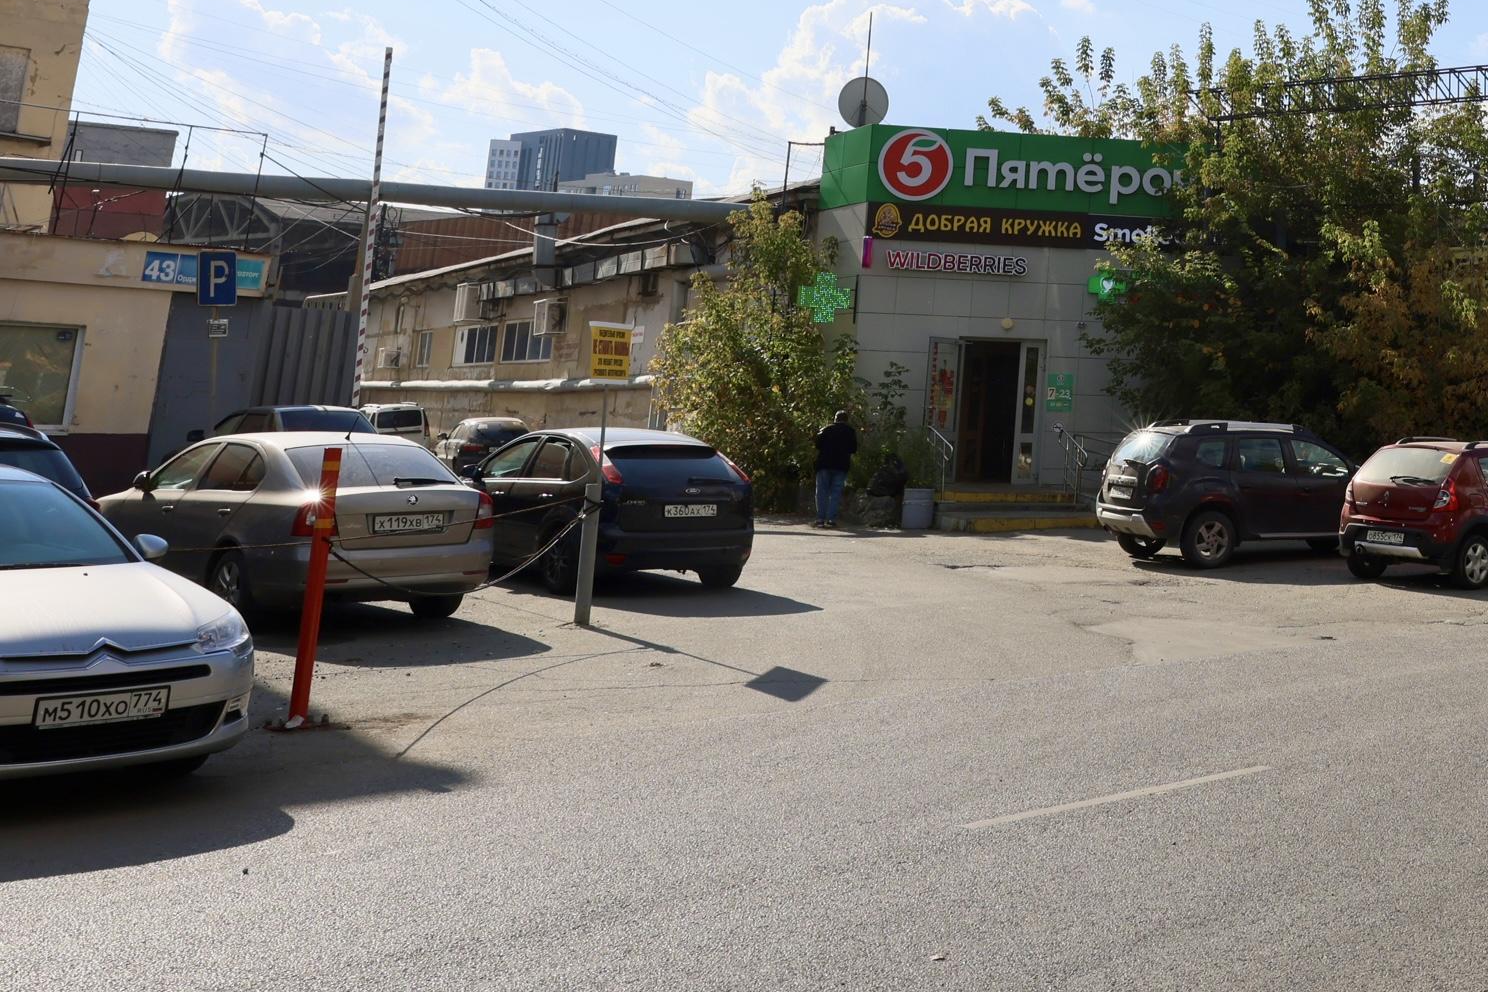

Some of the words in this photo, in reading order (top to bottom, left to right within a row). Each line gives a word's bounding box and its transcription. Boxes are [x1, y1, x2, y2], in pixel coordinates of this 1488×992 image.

[908, 213, 991, 233] ДОБРАЯ
[1001, 218, 1082, 238] КРУЖКА
[144, 260, 176, 281] 43
[887, 250, 1028, 275] WILDBERRIES
[424, 515, 441, 524] 174
[42, 698, 128, 722] М510ХО
[133, 691, 162, 709] 774
